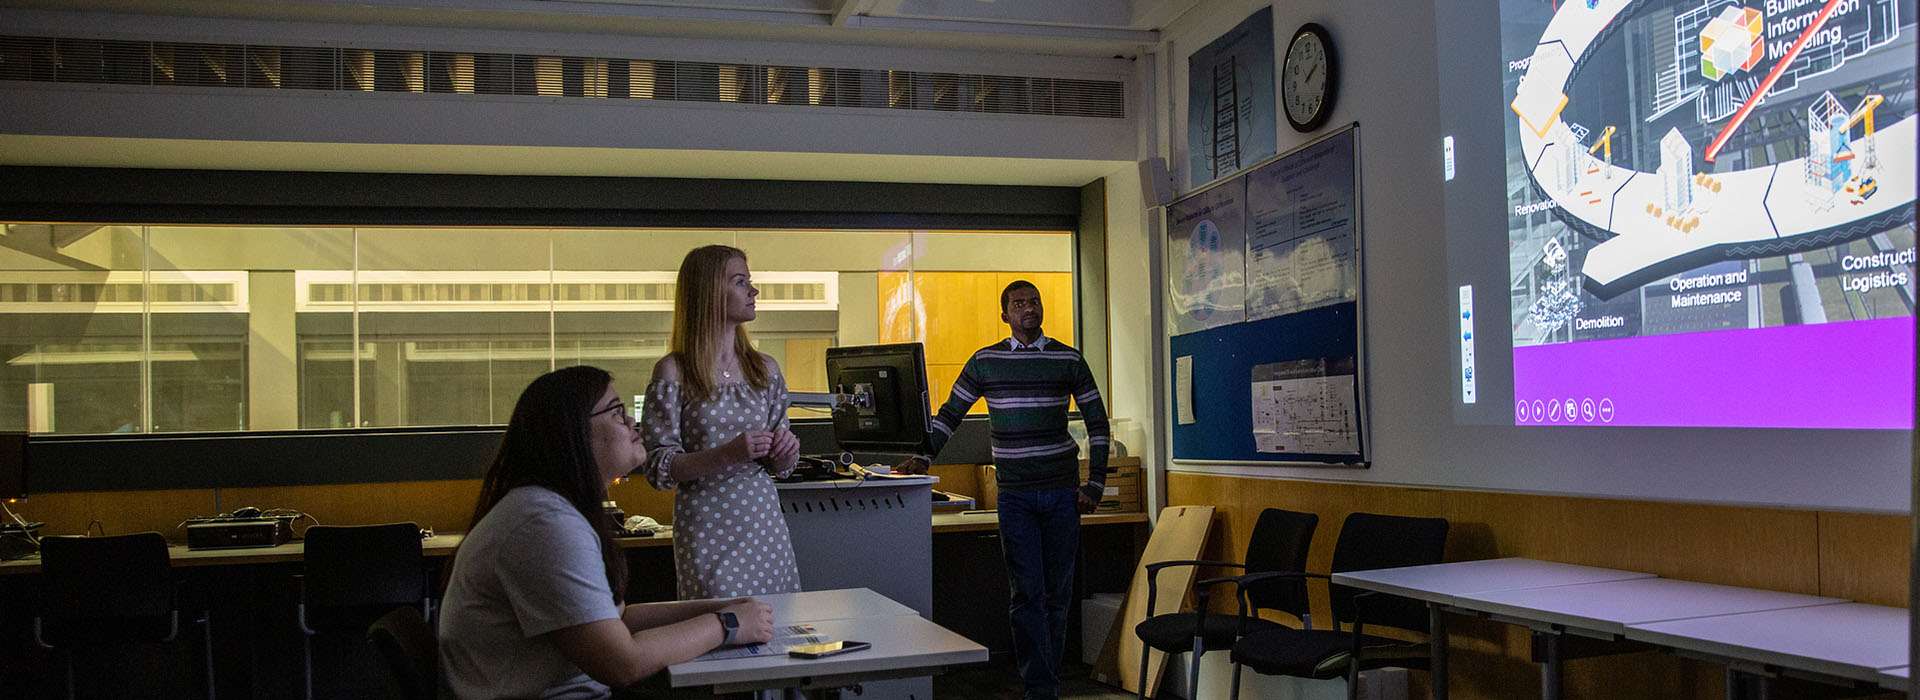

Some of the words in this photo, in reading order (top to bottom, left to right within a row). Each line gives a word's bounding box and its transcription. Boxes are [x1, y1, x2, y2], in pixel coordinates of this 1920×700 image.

[1766, 0, 1830, 18] Build
[1767, 0, 1860, 39] Informion
[1768, 25, 1842, 60] Moling
[1670, 273, 1724, 292] Operation
[1725, 269, 1747, 286] and
[1842, 271, 1908, 293] Logistics
[1671, 290, 1742, 308] Maintenance
[1575, 315, 1625, 330] Demolition
